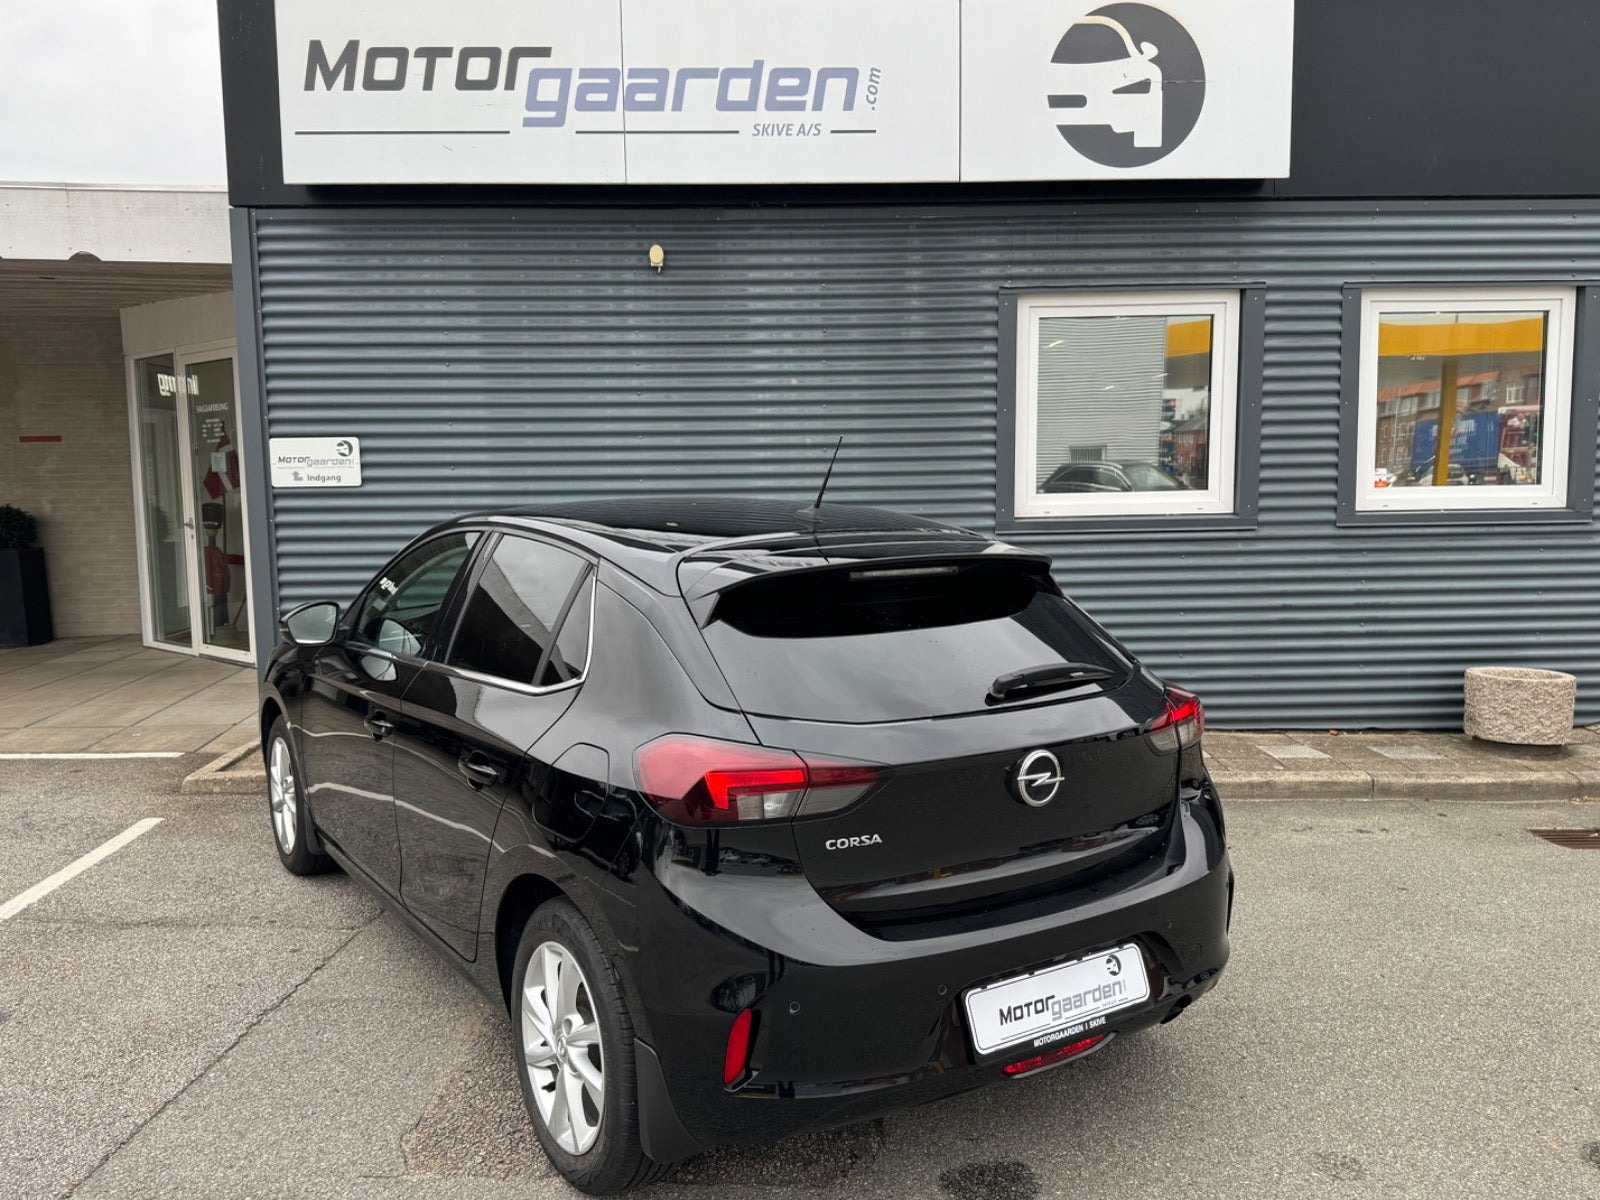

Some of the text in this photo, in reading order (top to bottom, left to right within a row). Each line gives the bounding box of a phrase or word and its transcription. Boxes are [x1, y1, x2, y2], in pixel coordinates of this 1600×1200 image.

[752, 122, 822, 137] SKIVE A/S
[306, 474, 342, 483] Indgang
[825, 833, 883, 850] CORSA
[1033, 1023, 1084, 1048] MOTORGAARDEN
[1089, 1016, 1107, 1029] SKIVE
